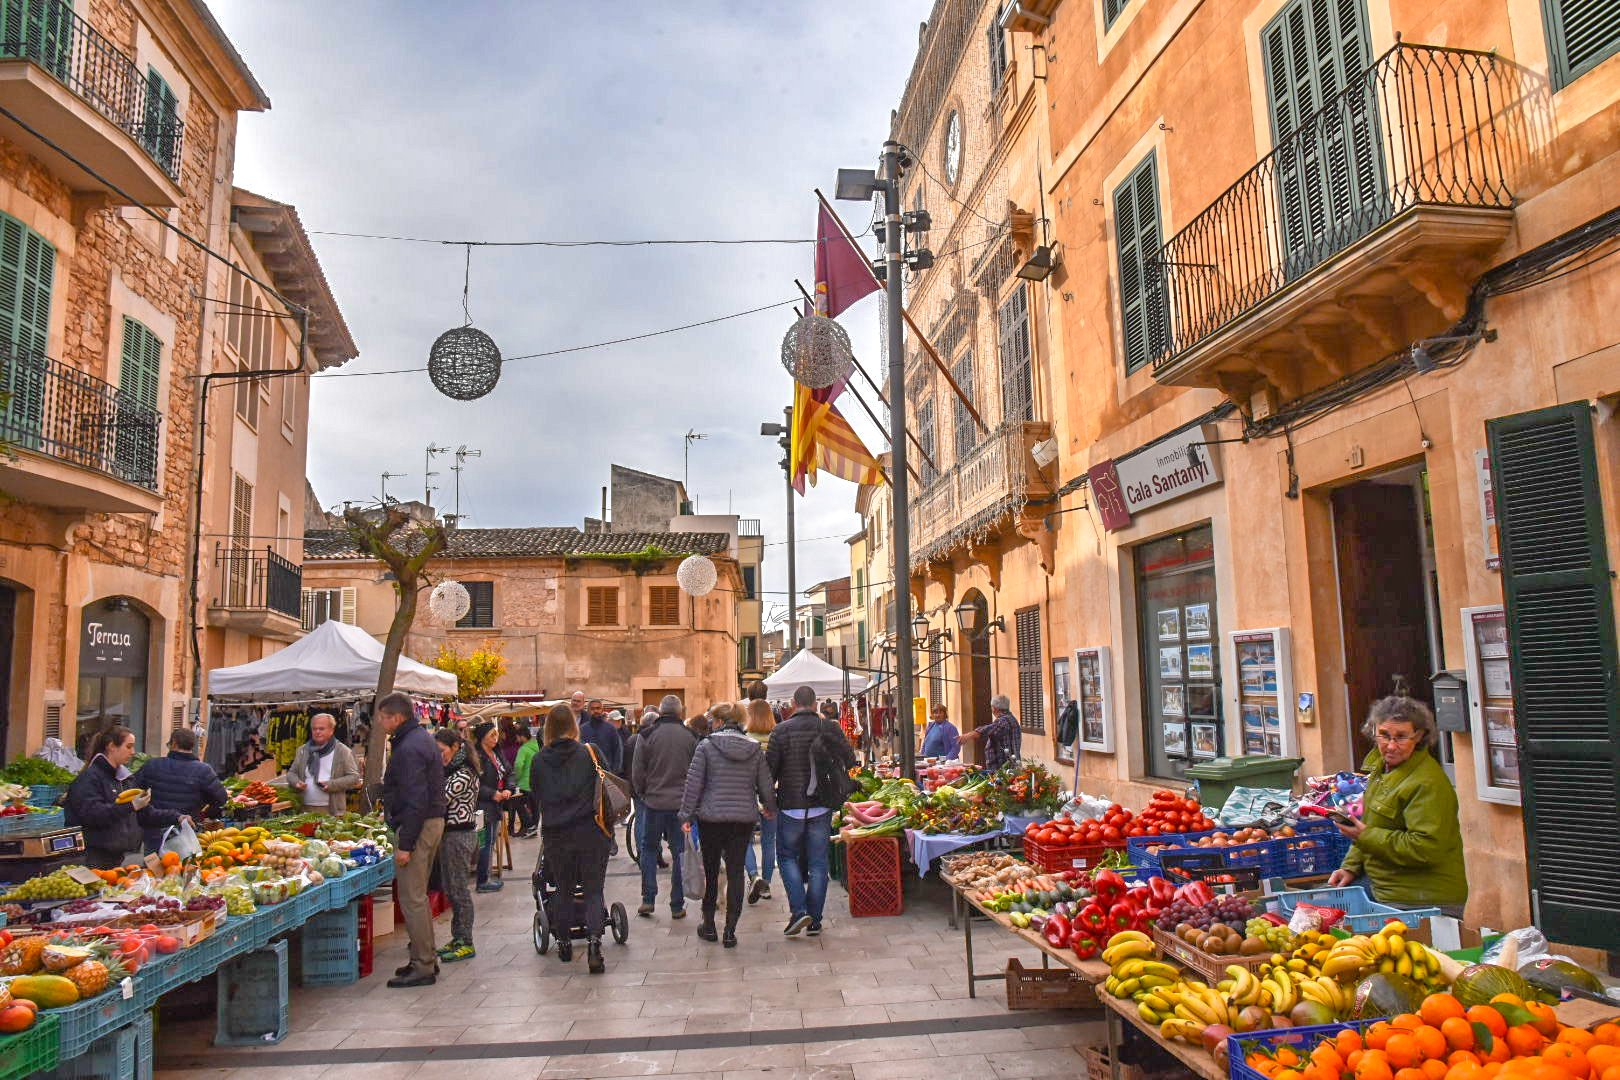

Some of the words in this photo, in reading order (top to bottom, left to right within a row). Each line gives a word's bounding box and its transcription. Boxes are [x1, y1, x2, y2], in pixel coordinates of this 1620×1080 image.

[1156, 442, 1201, 468] Inmobilia
[1127, 481, 1153, 504] Cala
[1152, 454, 1209, 495] Santanyí
[88, 622, 131, 647] Terrasa
